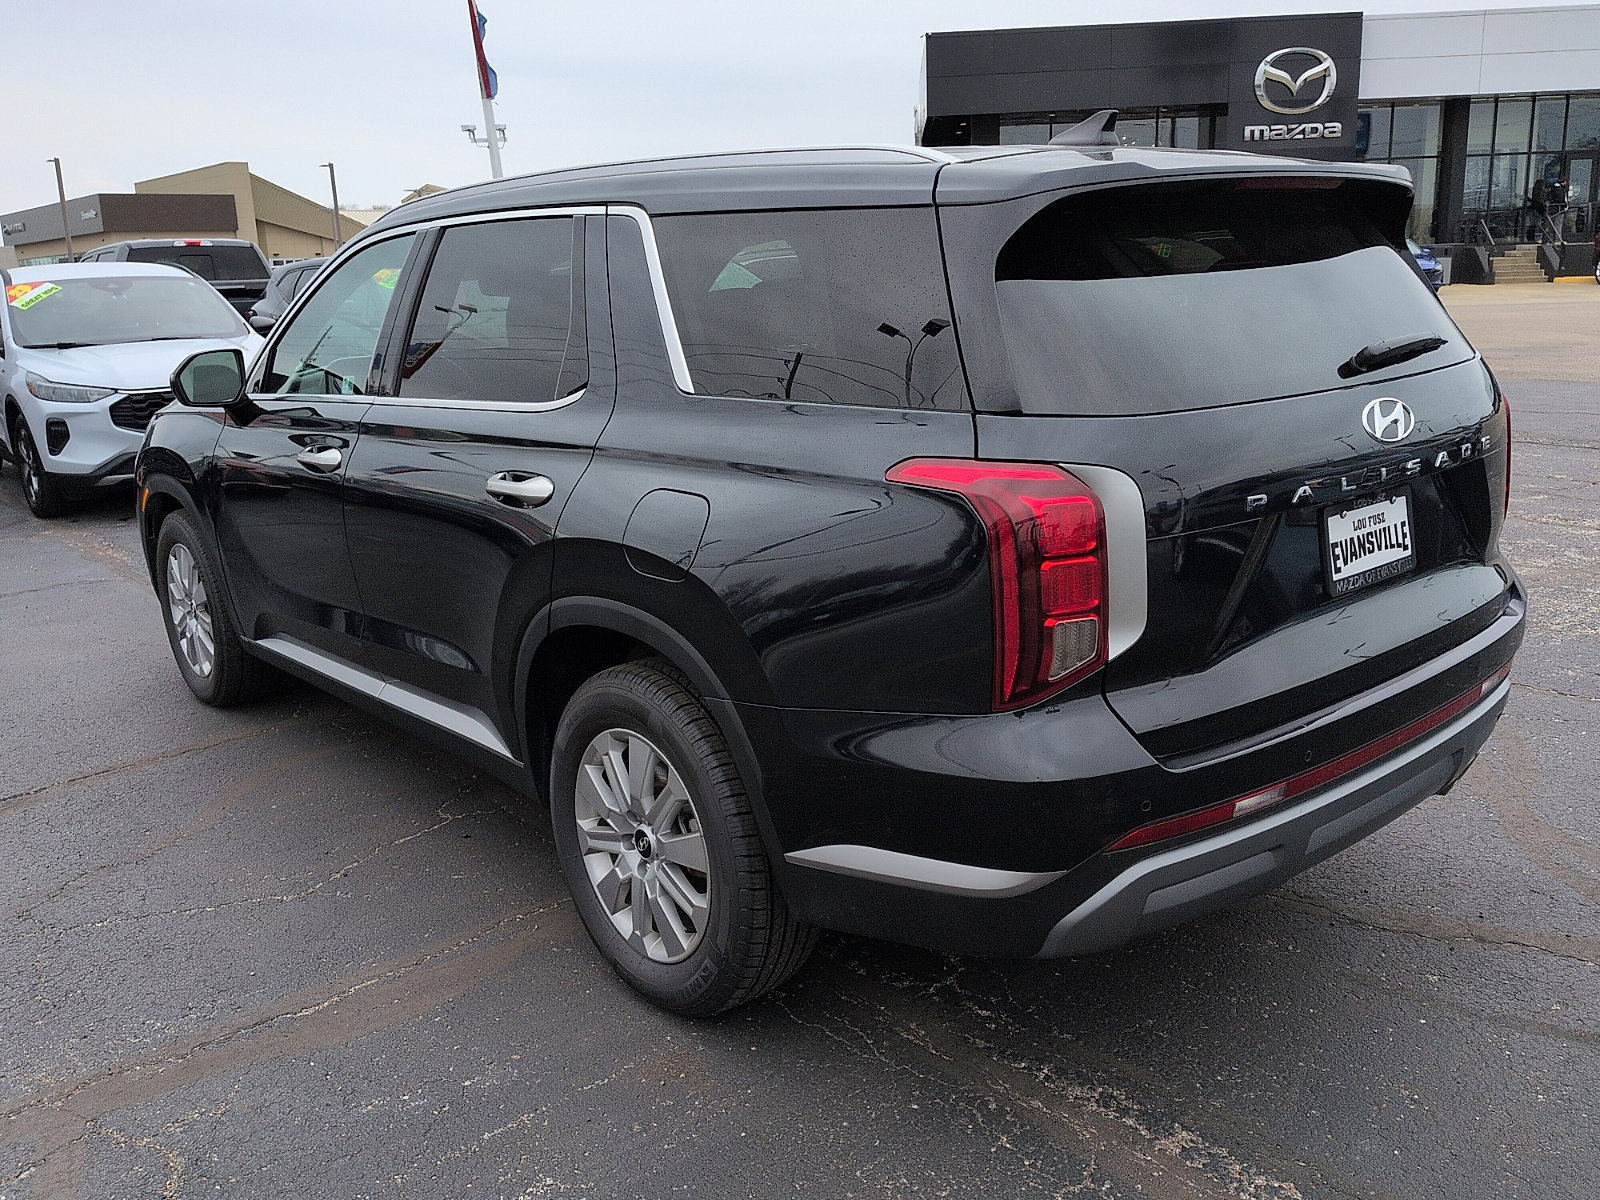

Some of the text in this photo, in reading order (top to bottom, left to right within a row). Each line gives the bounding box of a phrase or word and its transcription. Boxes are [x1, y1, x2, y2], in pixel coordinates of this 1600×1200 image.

[1246, 435, 1491, 512] PALISADE
[1352, 512, 1386, 532] LOU FUSZ
[1330, 520, 1409, 575] EVANSVILLE
[1336, 557, 1412, 593] MAZDA OF EVANSVILLE
